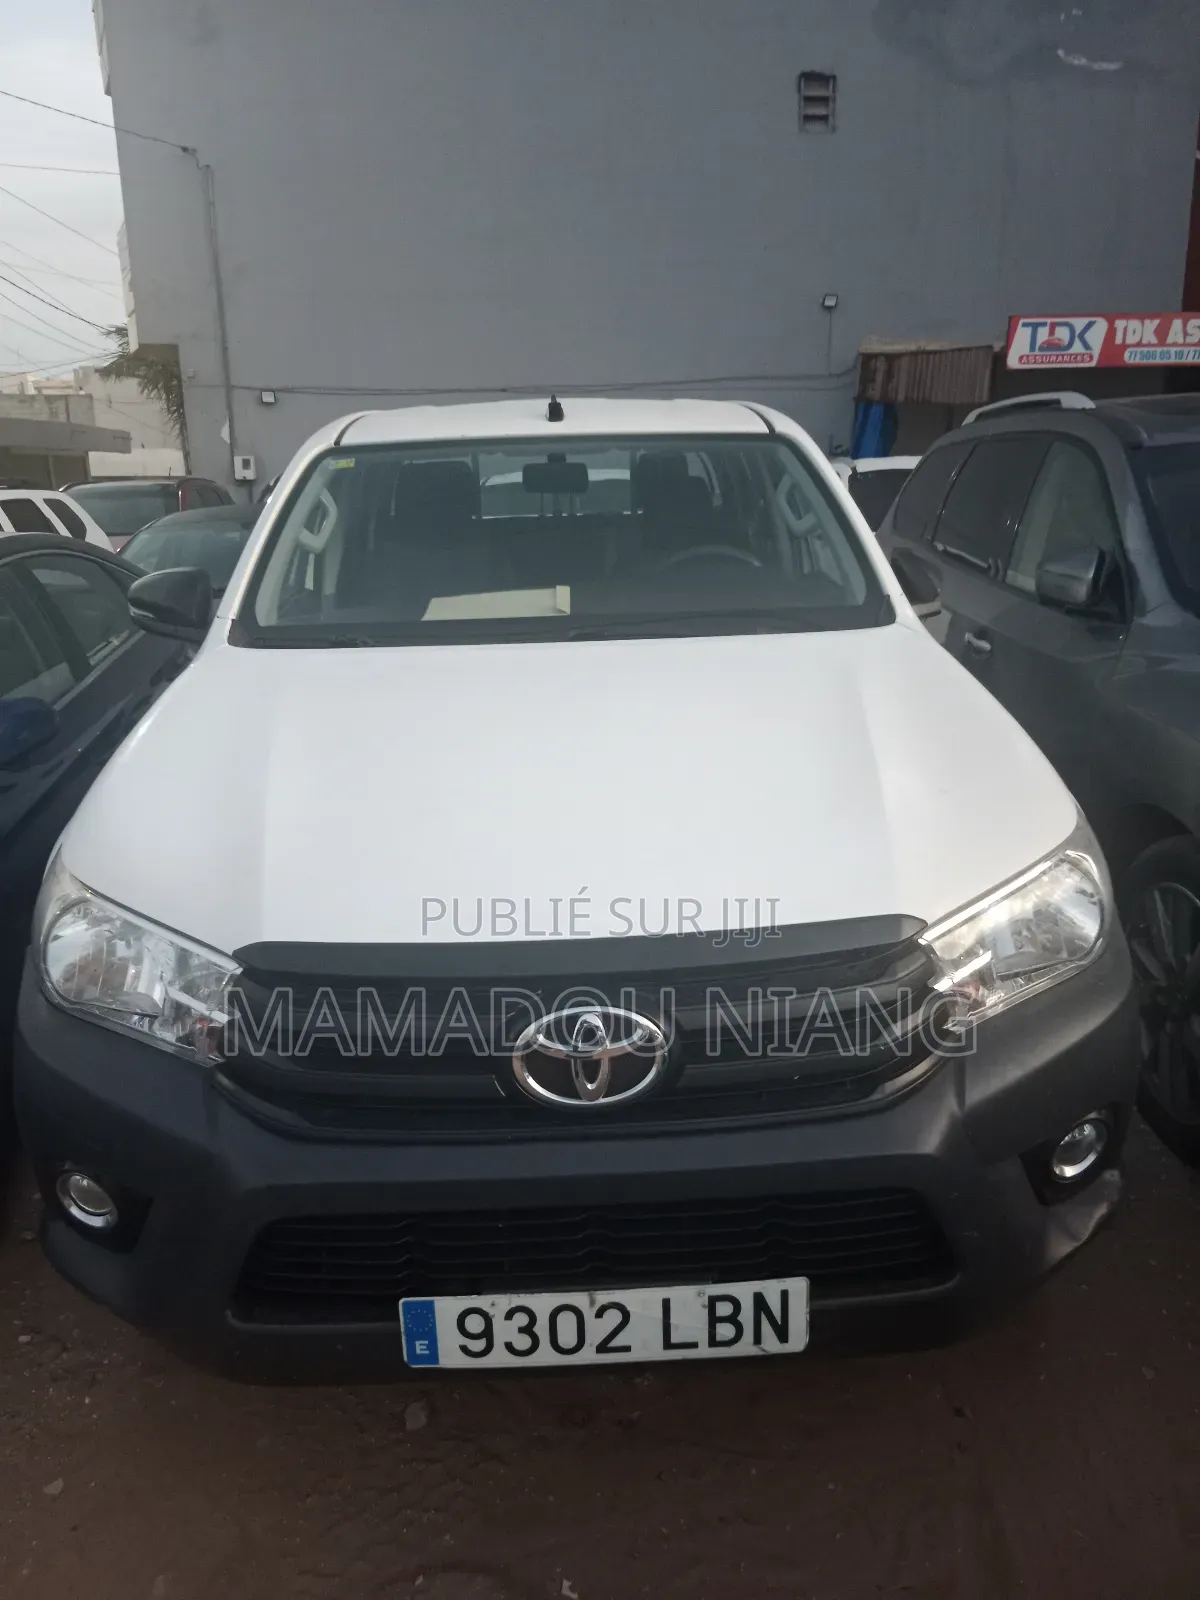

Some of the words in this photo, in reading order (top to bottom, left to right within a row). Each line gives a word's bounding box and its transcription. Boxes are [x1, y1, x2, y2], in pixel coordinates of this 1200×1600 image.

[1021, 320, 1097, 353] TDK
[1114, 320, 1160, 345] TDK
[1021, 355, 1092, 364] ASSURANCES
[455, 1301, 632, 1359] 9302
[661, 1289, 790, 1351] LBN
[415, 1340, 430, 1355] E
